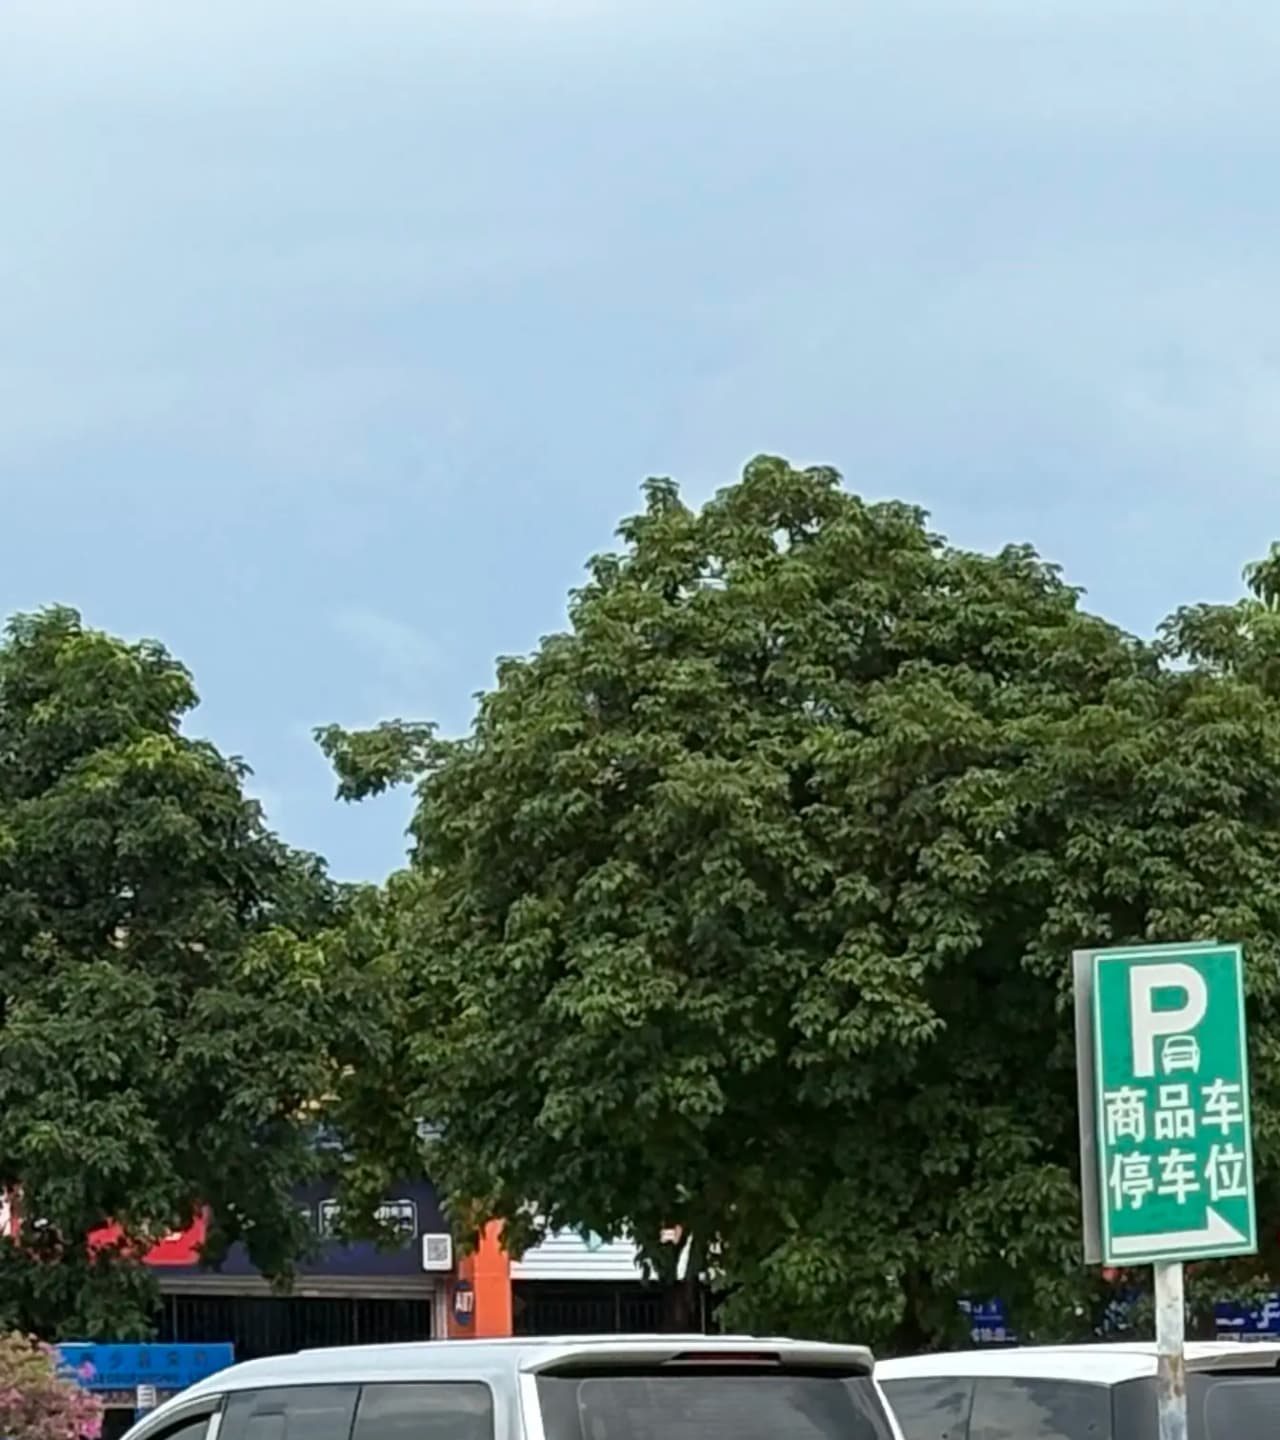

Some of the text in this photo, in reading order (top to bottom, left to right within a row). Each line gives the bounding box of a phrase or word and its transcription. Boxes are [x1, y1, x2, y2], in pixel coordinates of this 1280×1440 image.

[1130, 963, 1208, 1078] P
[1103, 1078, 1243, 1146] 商品车
[1108, 1143, 1248, 1211] 停车位
